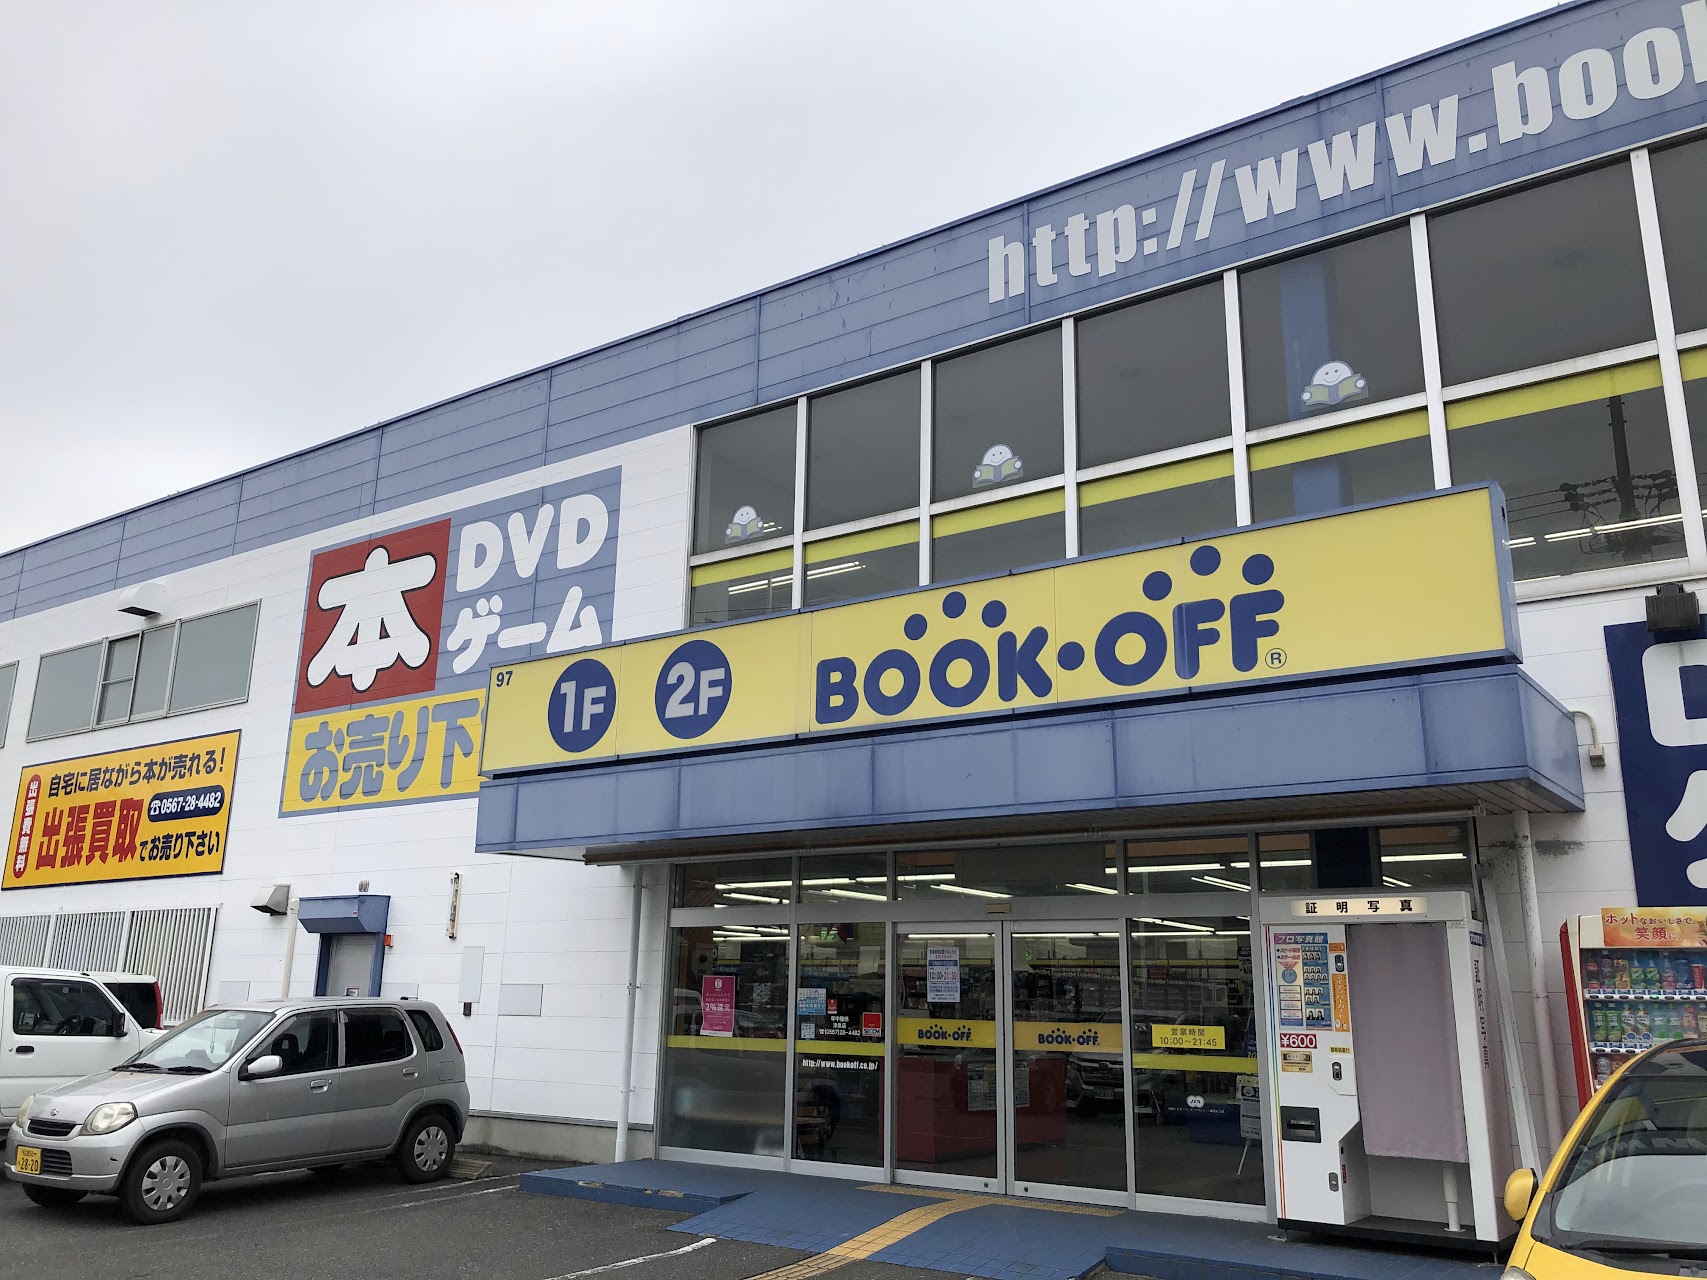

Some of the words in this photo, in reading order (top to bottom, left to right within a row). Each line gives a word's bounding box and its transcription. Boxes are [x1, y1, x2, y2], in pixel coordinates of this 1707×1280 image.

[456, 494, 609, 592] DVD
[306, 544, 437, 693] 本
[446, 586, 602, 674] ゲーム
[496, 670, 513, 687] 97
[664, 661, 725, 719] 2F
[560, 680, 607, 733] 1F
[161, 791, 221, 814] 0567-28-4482
[35, 797, 145, 870] 出張買取
[139, 829, 221, 862] でお売り下さい
[1305, 899, 1413, 914] 証明写真
[1635, 926, 1677, 941] 笑顔に
[1170, 1027, 1205, 1037] 営業時間
[1281, 1034, 1316, 1048] ¥600
[802, 1058, 879, 1071] http://www.bookoff.co.jp/
